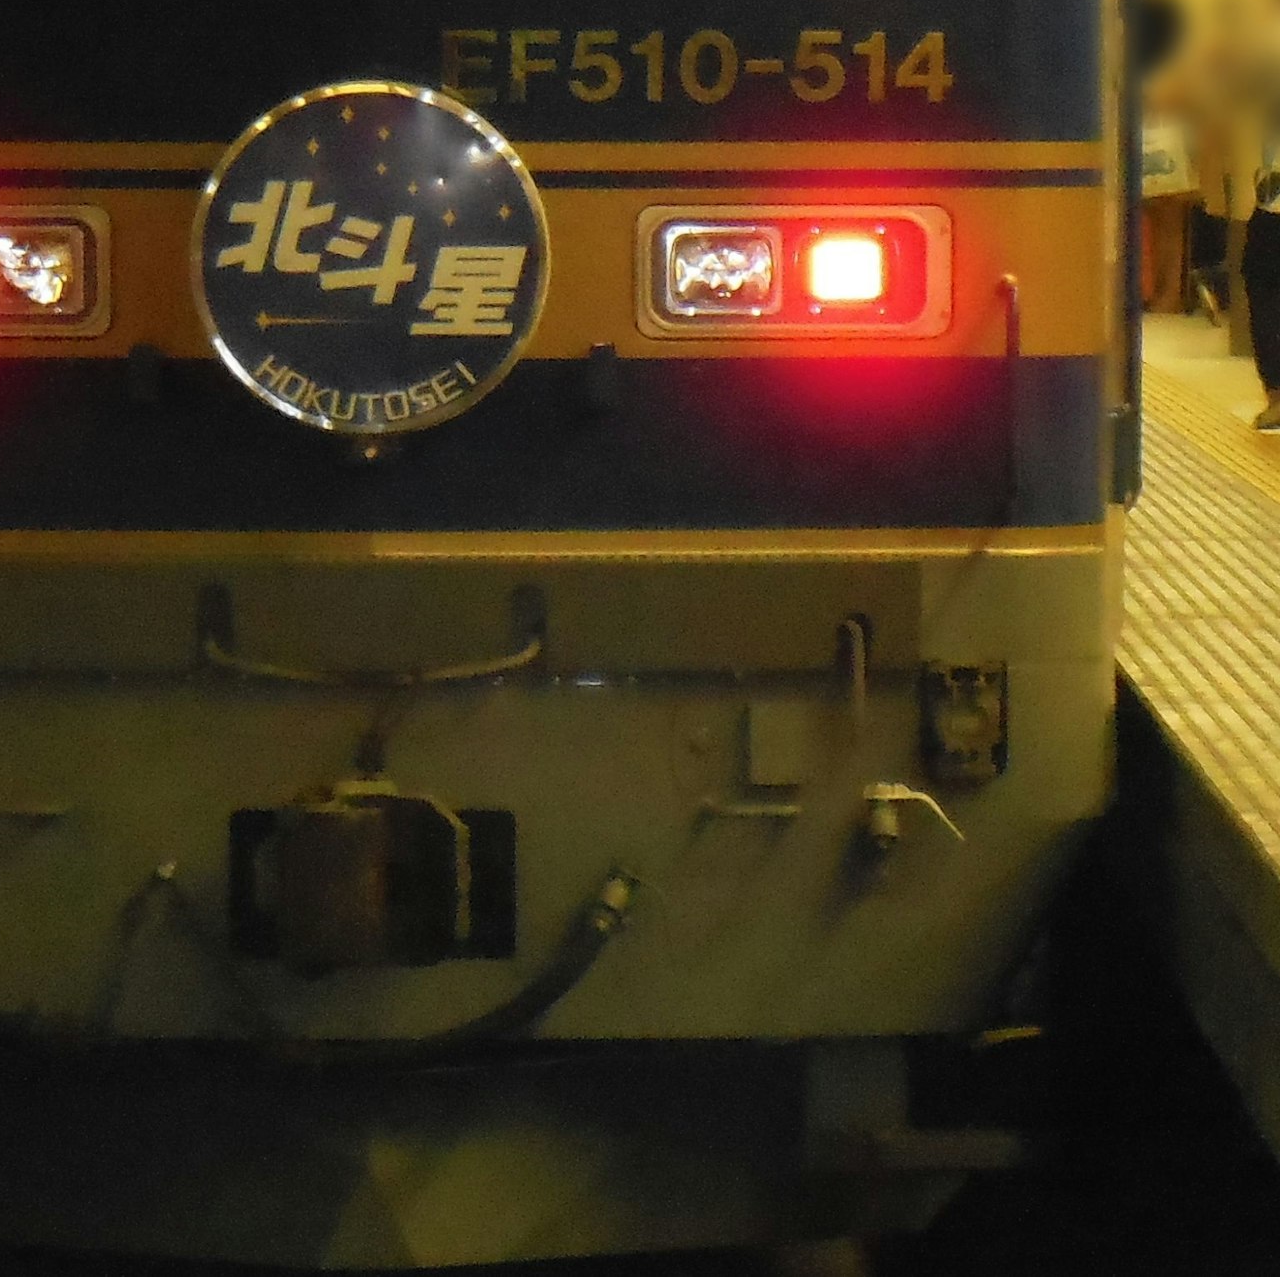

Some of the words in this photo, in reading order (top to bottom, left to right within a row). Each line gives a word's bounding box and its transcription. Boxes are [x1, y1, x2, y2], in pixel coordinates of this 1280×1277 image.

[441, 28, 954, 104] EF510-514
[217, 180, 528, 336] 北斗星
[256, 355, 477, 421] HOKUTOSEI
